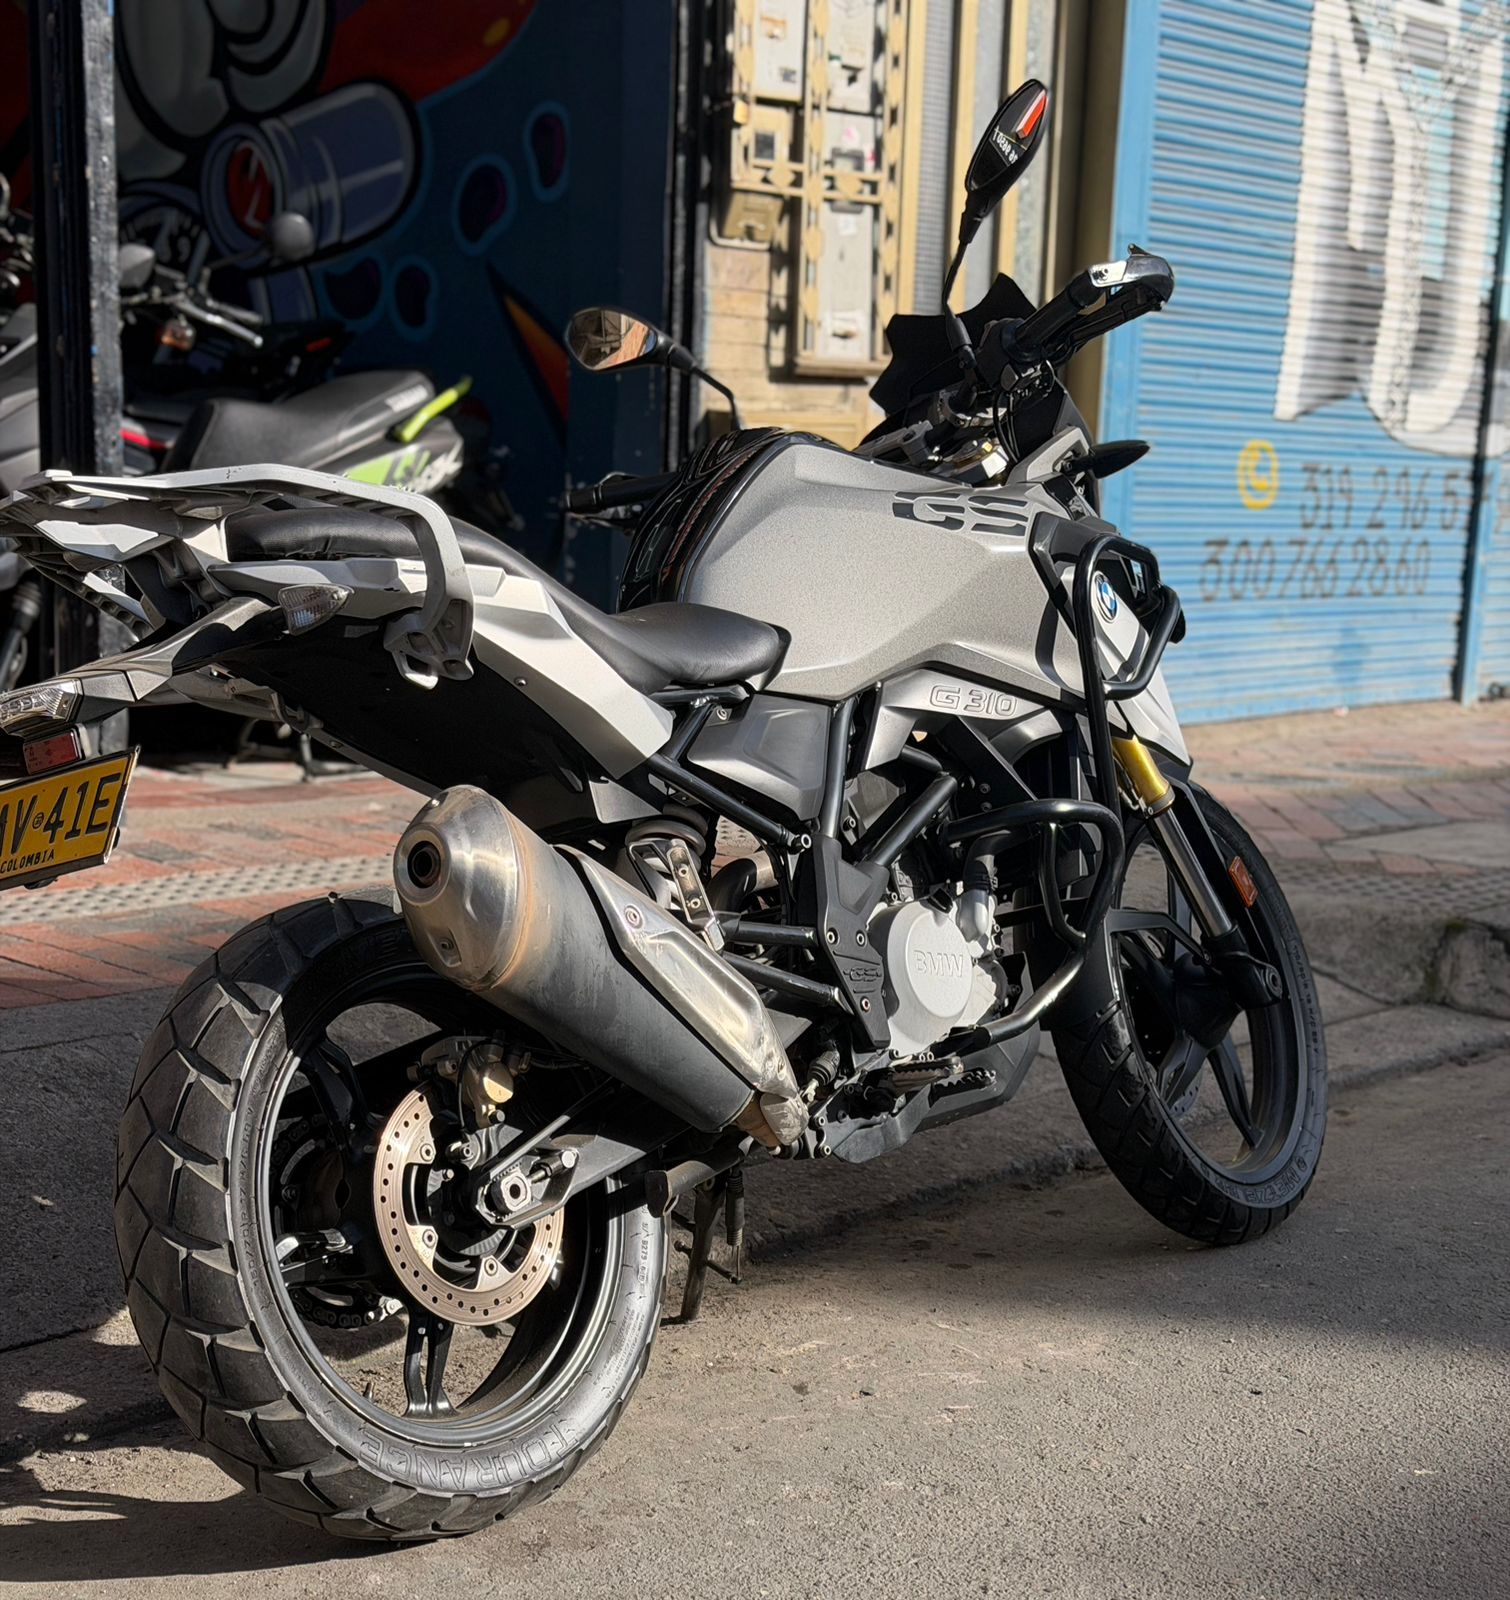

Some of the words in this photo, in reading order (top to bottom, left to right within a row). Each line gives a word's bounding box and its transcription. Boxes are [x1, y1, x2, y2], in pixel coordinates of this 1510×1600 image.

[892, 491, 1029, 537] GS
[1299, 464, 1353, 530] 319
[929, 684, 962, 709] G
[963, 689, 1018, 716] 310
[43, 772, 122, 844] 41E
[0, 848, 55, 874] COLOMBIA
[913, 949, 963, 978] BMW
[359, 1423, 579, 1490] TOURANCE
